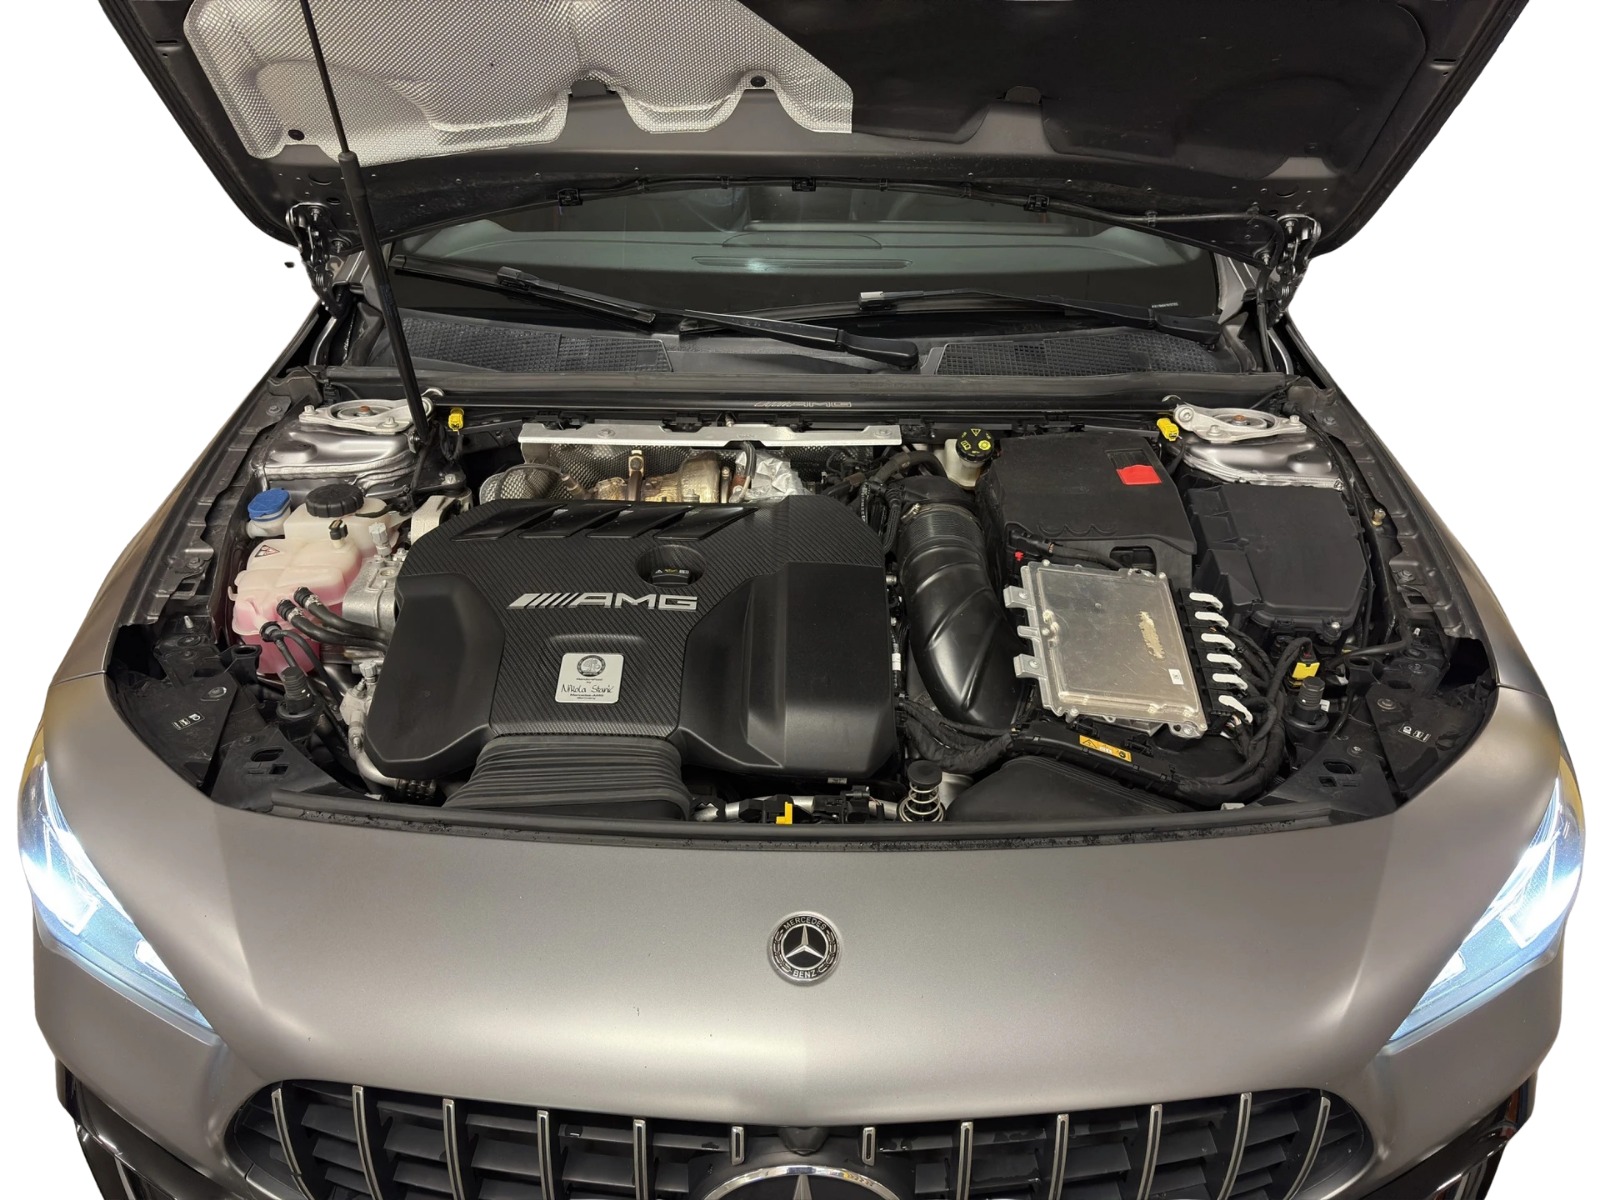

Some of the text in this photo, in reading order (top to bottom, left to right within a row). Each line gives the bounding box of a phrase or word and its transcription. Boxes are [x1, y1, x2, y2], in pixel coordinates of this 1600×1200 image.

[568, 592, 698, 612] AMG
[783, 916, 827, 930] MERCEDES
[792, 969, 817, 979] BENZ
